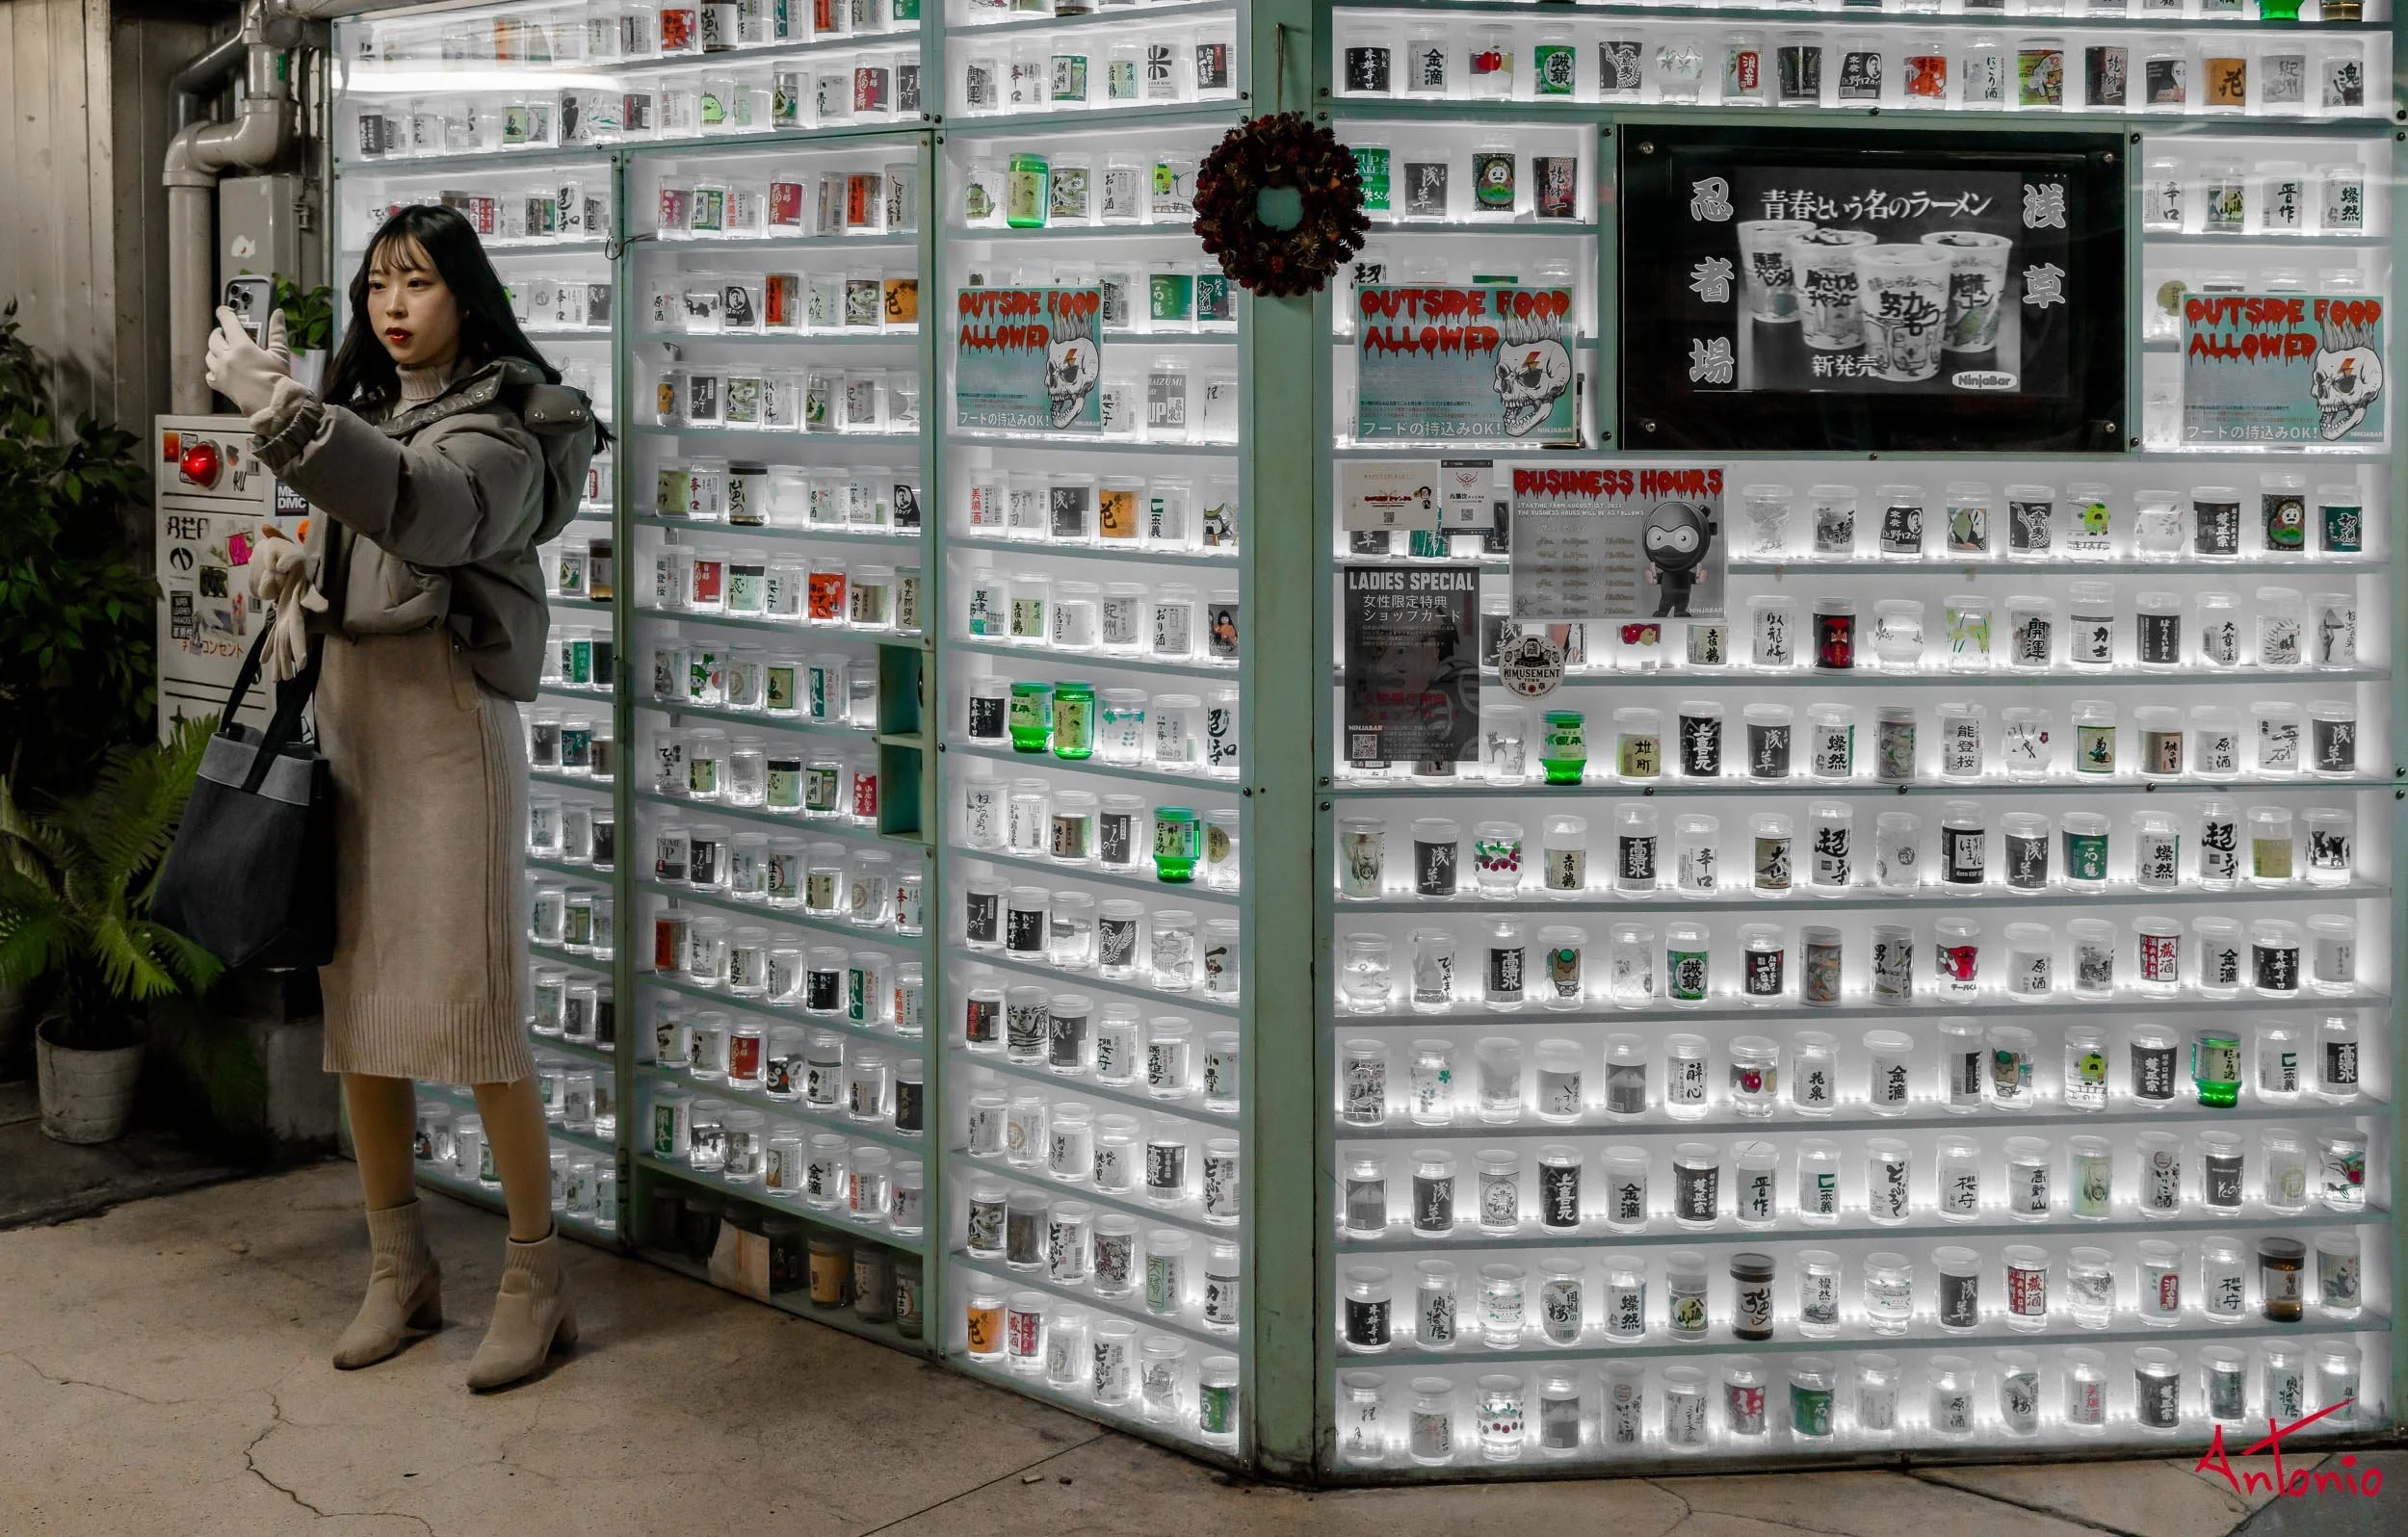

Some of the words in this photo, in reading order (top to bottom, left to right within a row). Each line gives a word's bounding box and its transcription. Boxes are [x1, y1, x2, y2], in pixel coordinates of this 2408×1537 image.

[1423, 48, 1444, 86] 金滴
[1760, 189, 1994, 221] 青春という名のラーメン
[2162, 182, 2181, 221] 辛口
[2023, 183, 2066, 309] 浅草
[957, 291, 1041, 325] OUTSIDE
[1048, 290, 1100, 324] FOOD
[1360, 290, 1486, 325] OUTSIDE
[1496, 290, 1570, 325] FOOD
[2185, 298, 2305, 332] OUTSIDE
[2314, 299, 2381, 332] FOOD
[959, 325, 1050, 356] ALLOWED
[1363, 326, 1500, 360] ALLOWED
[2187, 333, 2317, 367] ALLOWED
[1812, 353, 1882, 378] 新発売
[1958, 376, 2011, 387] NinjaBar
[959, 414, 1050, 428] フードの持込みOK!
[1363, 422, 1501, 436] フードの持込みOK!
[2186, 426, 2317, 439] フードの持込みOK!
[276, 495, 308, 509] DMC
[1513, 469, 1635, 502] BUSINESS
[1640, 469, 1724, 502] HOURS
[1349, 571, 1404, 589] LADIES
[1409, 572, 1475, 590] SPECIAL
[1363, 594, 1448, 609] 女性限定特典
[2026, 616, 2051, 660] 開運
[2092, 627, 2109, 658] 力士
[1755, 729, 1784, 770] 浅草
[2215, 738, 2232, 769] 原酒
[2321, 724, 2350, 767] 浅草
[1421, 846, 1451, 889] 浅草
[1695, 847, 1714, 888] 辛口
[2014, 841, 2042, 882] 浅草
[2031, 958, 2047, 991] 原酒
[2218, 948, 2238, 984] 金滴
[1886, 1065, 1907, 1101] 金滴
[1423, 1181, 1451, 1224] 浅草
[1618, 1183, 1641, 1219] 金滴
[2029, 1169, 2048, 1211] 高野山
